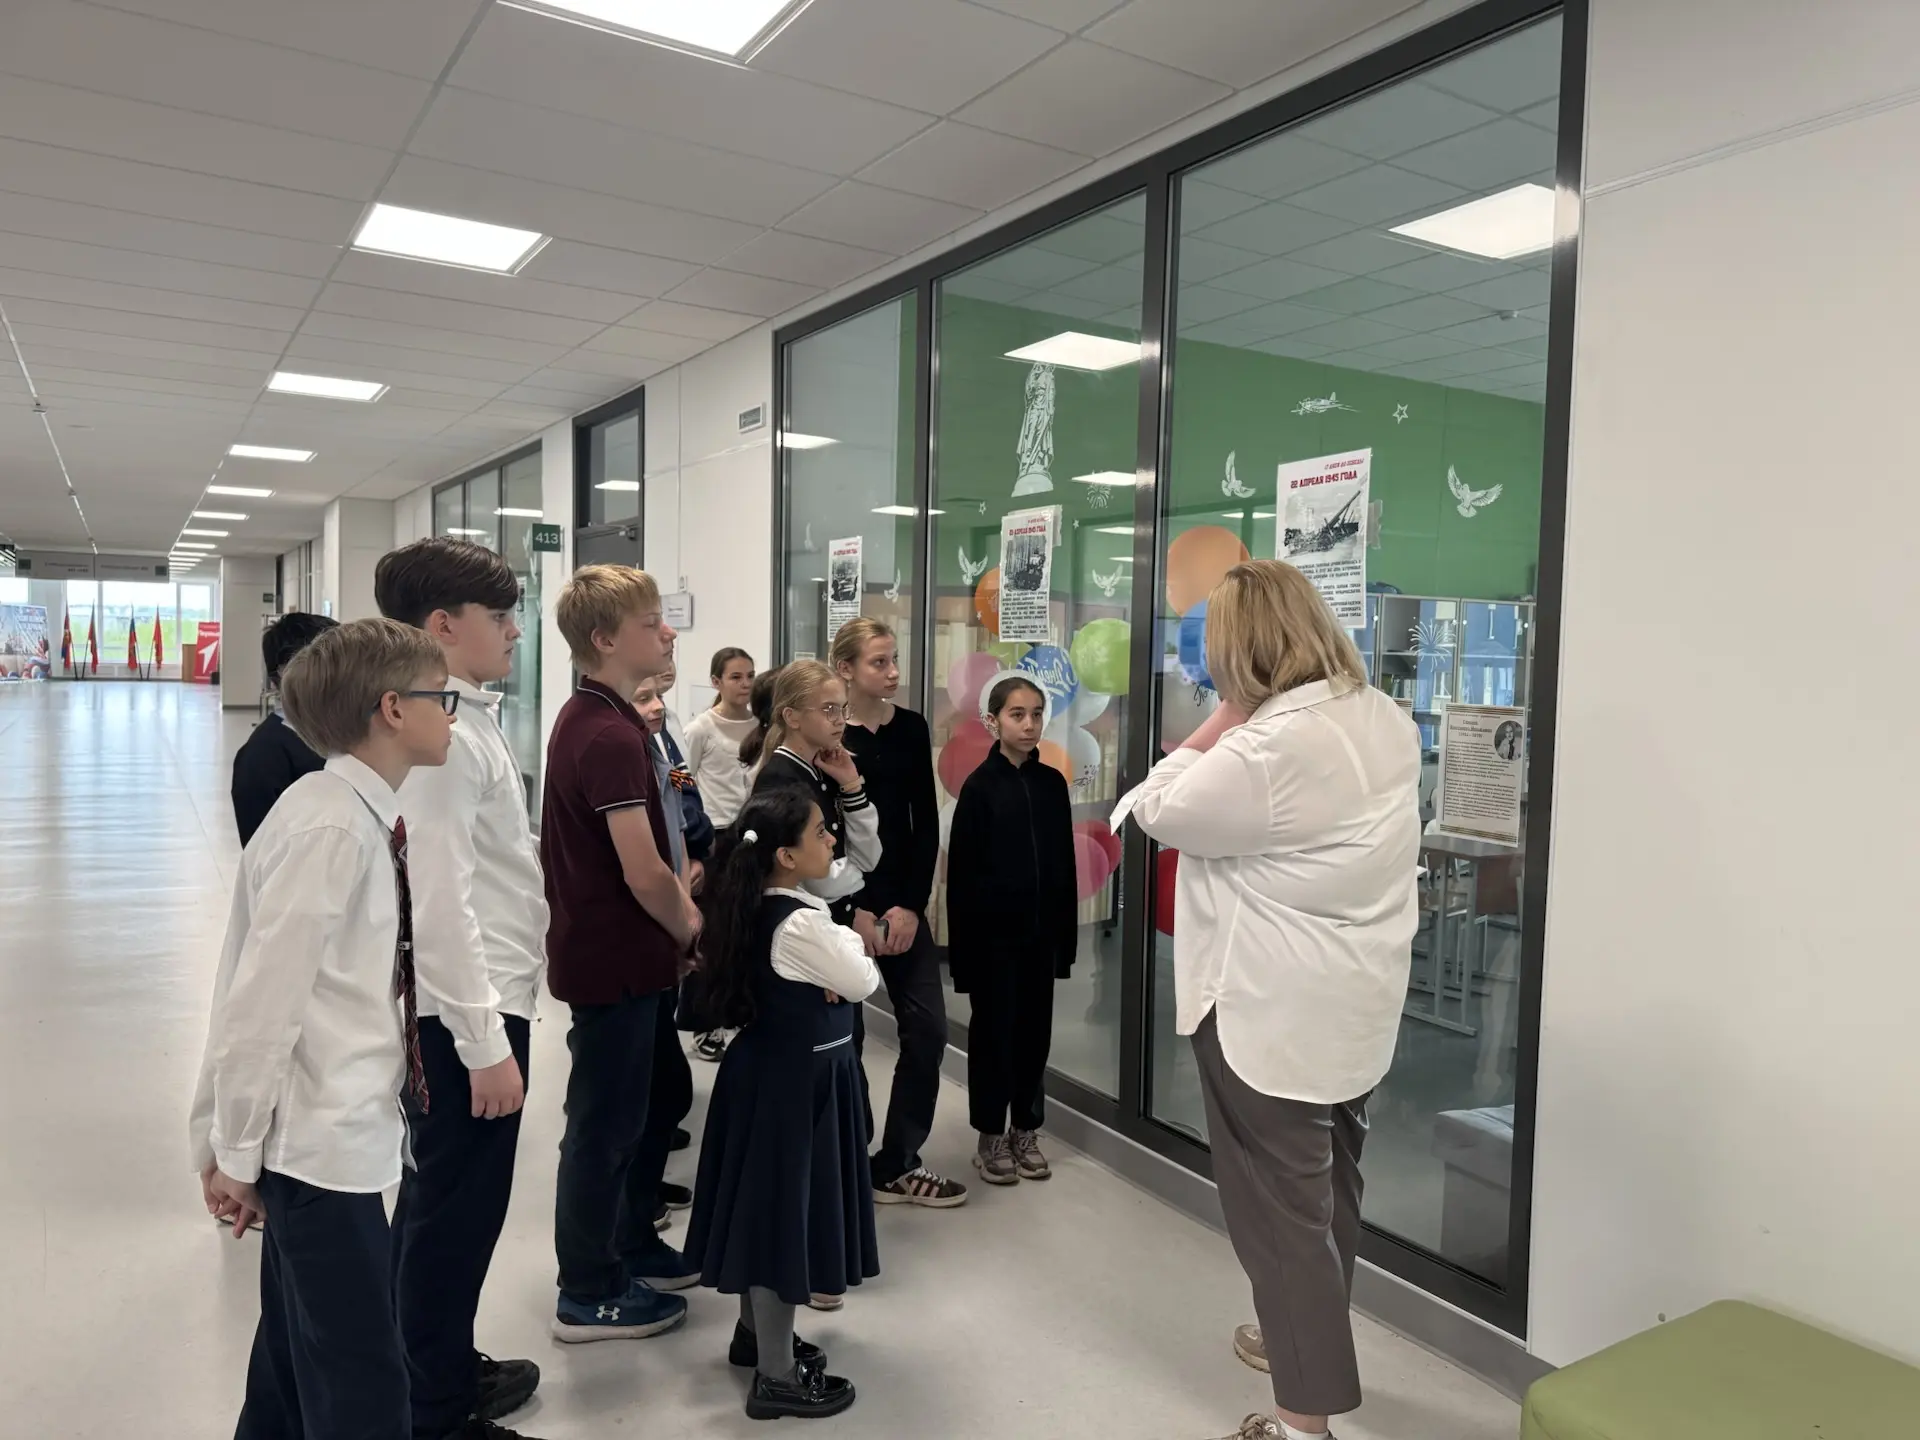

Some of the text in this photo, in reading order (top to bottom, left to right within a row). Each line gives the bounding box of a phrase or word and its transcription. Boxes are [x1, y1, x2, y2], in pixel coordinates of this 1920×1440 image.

[1299, 475, 1324, 488] АПРЕЛЯ
[1325, 473, 1339, 484] 1945
[1340, 470, 1358, 481] ГОДА
[535, 532, 559, 545] 413
